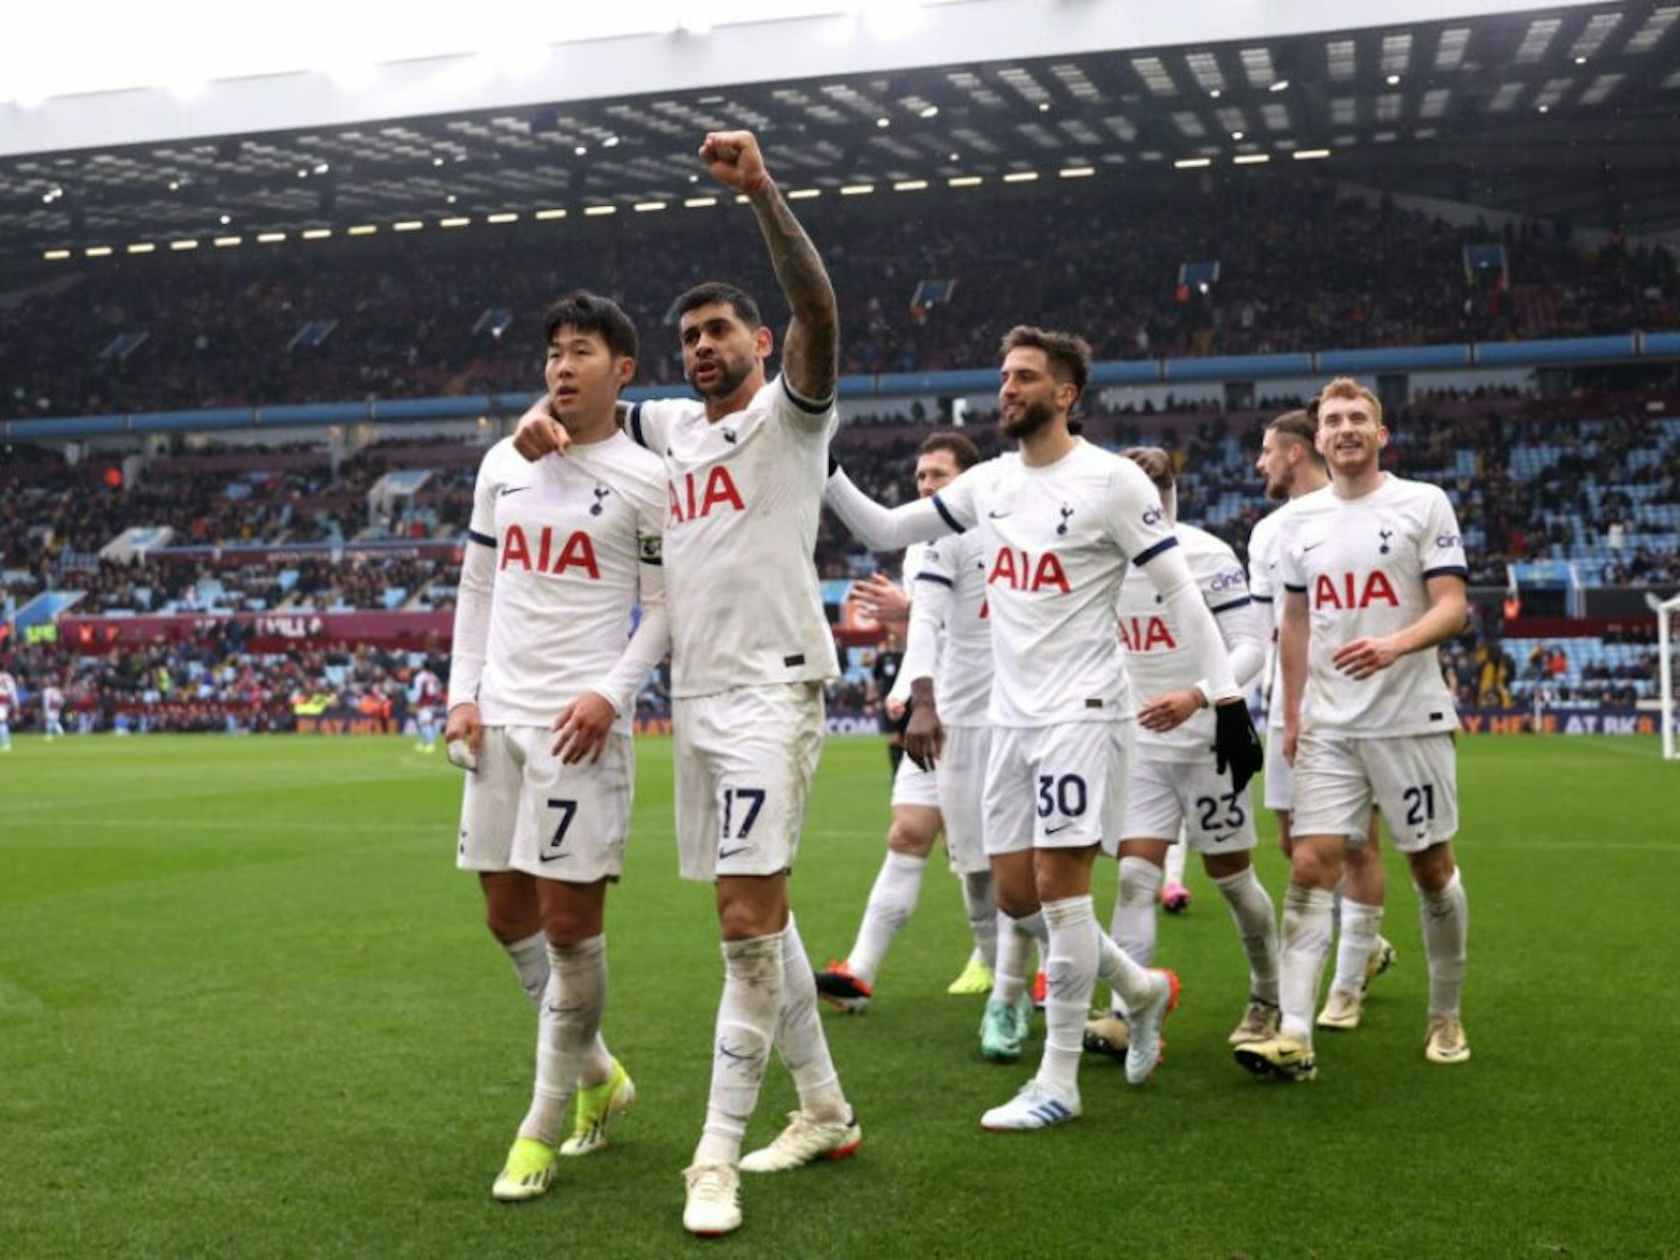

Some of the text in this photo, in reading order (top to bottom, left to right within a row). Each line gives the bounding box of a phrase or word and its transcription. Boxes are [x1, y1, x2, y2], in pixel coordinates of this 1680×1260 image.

[500, 524, 601, 580] AIA
[988, 546, 1071, 594] AIA
[1314, 570, 1400, 611] AIA
[1565, 715, 1597, 735] AT
[723, 788, 766, 839] 17
[1037, 774, 1087, 817] 30
[1196, 794, 1245, 830] 23
[1403, 784, 1435, 826] 21
[546, 799, 577, 848] 7
